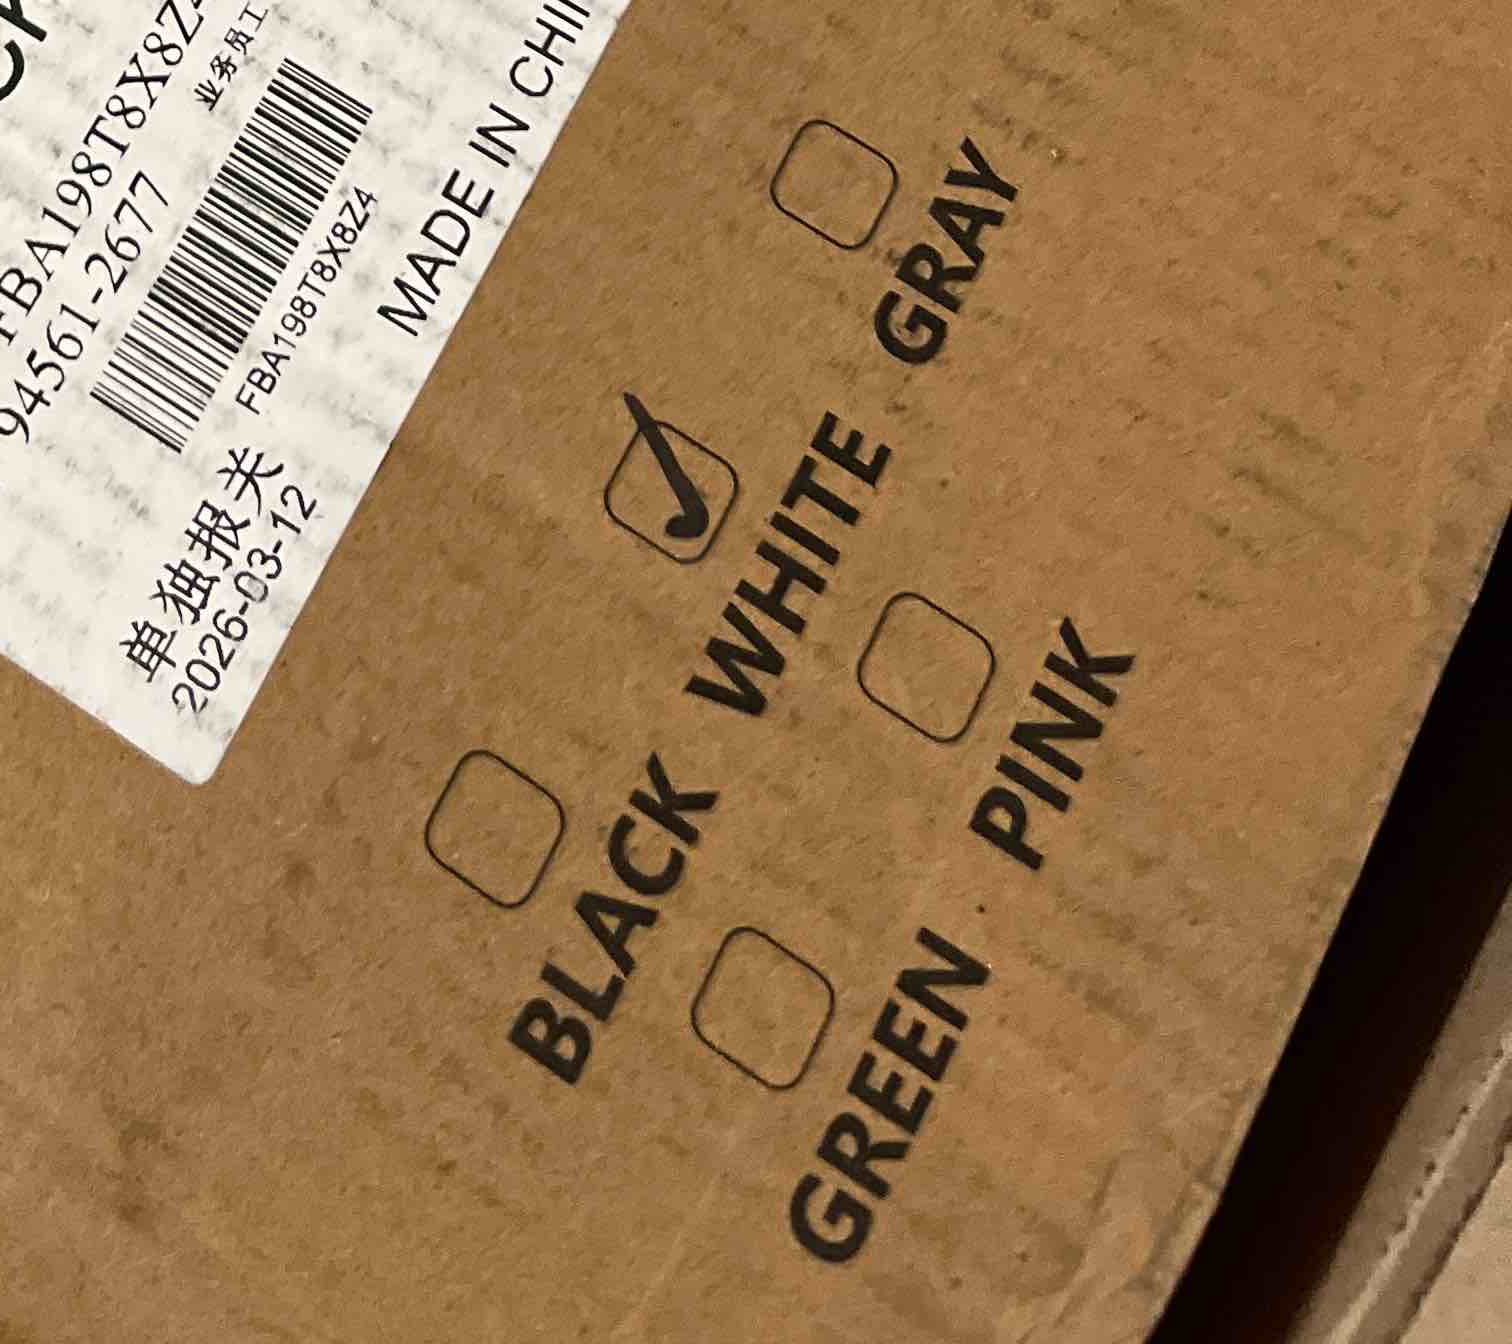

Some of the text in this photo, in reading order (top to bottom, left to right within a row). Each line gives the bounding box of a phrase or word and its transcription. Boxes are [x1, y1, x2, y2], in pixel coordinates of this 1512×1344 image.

[235, 187, 378, 415] FBA198T8X8Z4
[377, 168, 494, 336] MADE
[468, 103, 530, 168] IN
[120, 448, 284, 683] 单独报关
[172, 485, 317, 713] 2026-03-12
[509, 138, 1018, 1085] BLACK WHITE GRAY
[790, 617, 1134, 1265] GREEN PINK
